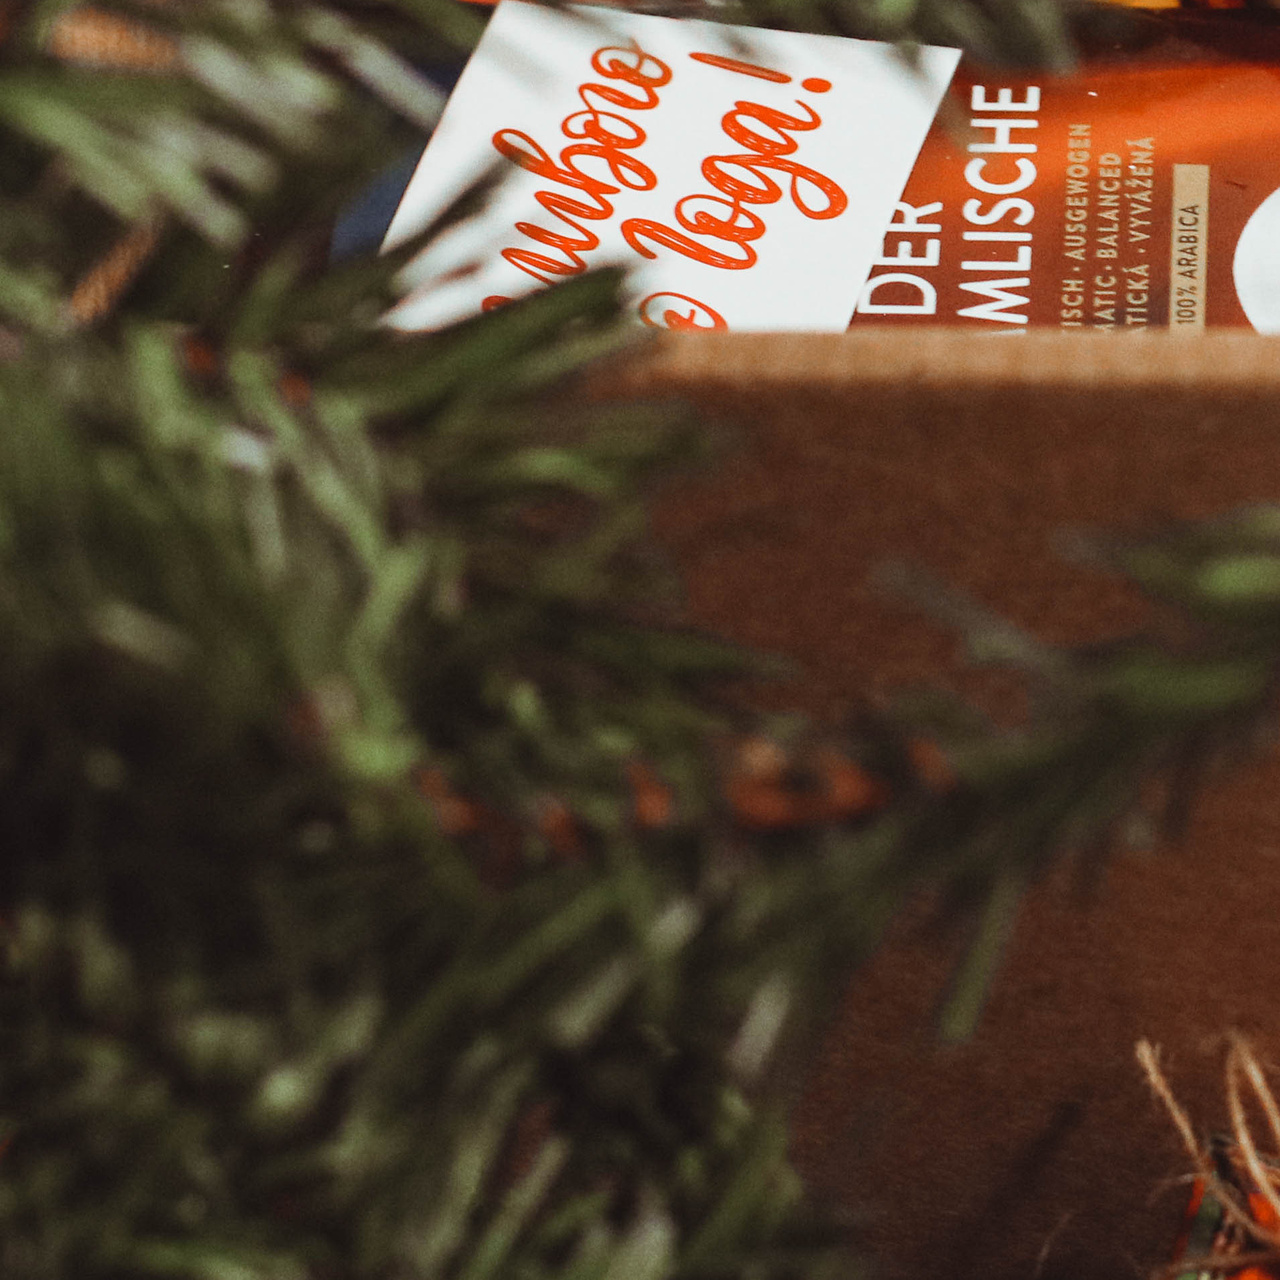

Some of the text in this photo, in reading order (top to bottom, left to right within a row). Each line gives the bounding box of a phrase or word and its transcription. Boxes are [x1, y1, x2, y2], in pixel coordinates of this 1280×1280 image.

[957, 84, 1041, 332] MLISCHE
[1064, 123, 1092, 261] AUSGEWOGEN
[1096, 152, 1123, 259] BALANCED
[1124, 136, 1155, 243] VYVÁŽENÁ
[856, 201, 943, 315] DER
[1176, 204, 1200, 324] 100% ARABICA
